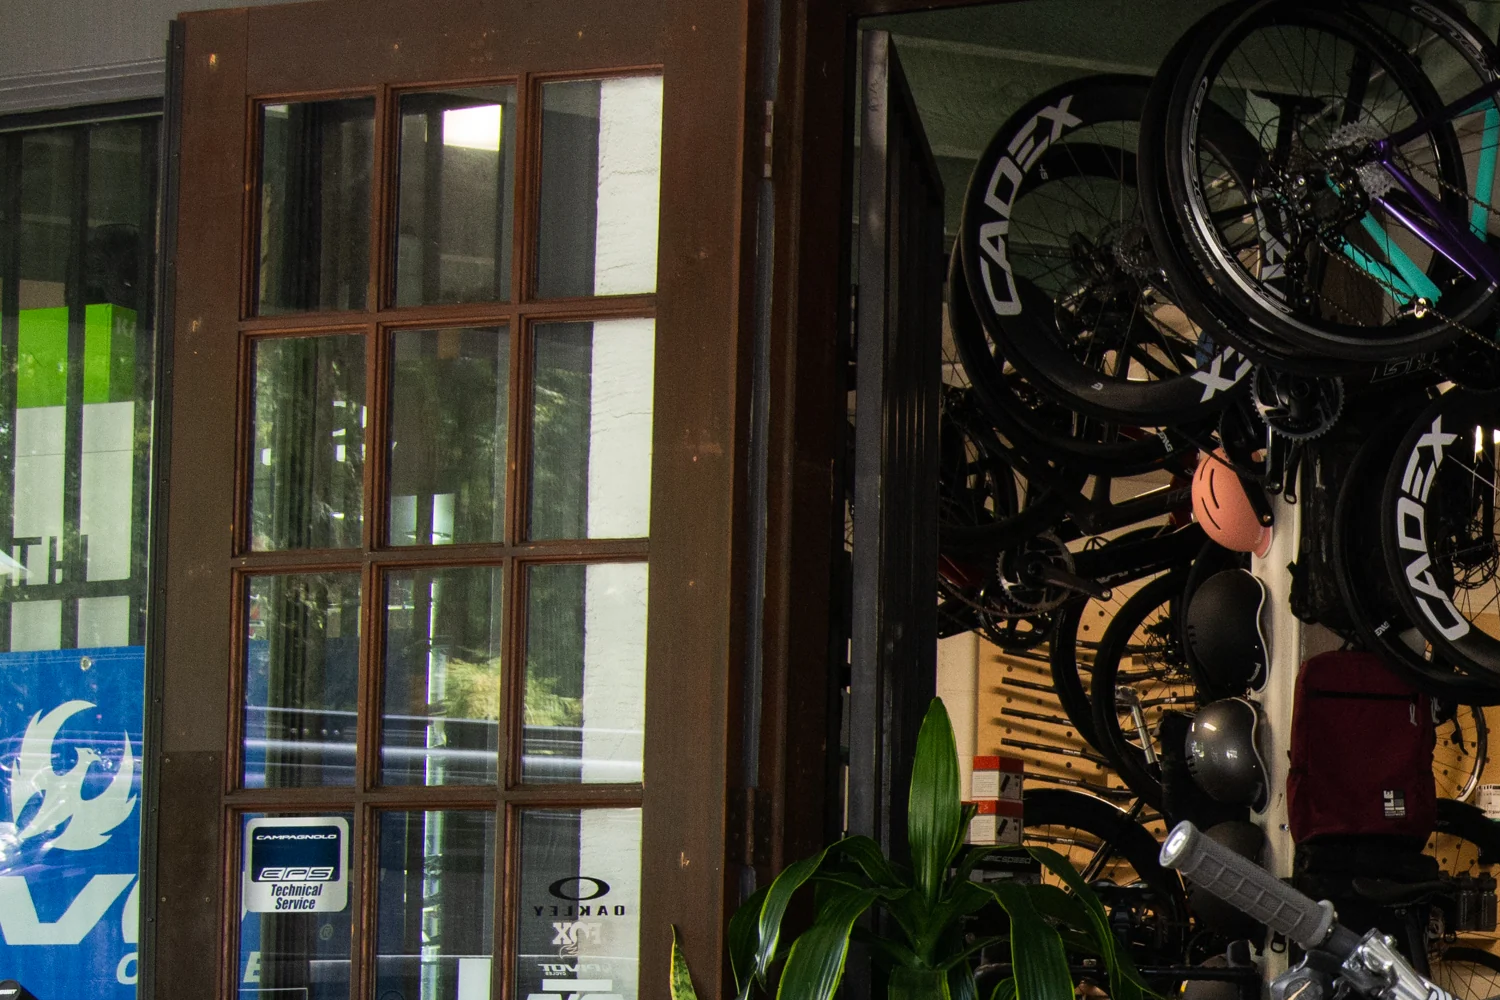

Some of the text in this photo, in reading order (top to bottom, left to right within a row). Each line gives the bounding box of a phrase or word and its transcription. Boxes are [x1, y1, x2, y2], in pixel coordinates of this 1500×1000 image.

[979, 94, 1084, 316] CADEX
[1397, 413, 1470, 641] CADEX
[256, 833, 338, 841] CAMPAGNOLO
[259, 867, 334, 881] EPS
[271, 884, 323, 897] Technical
[275, 897, 316, 910] Service
